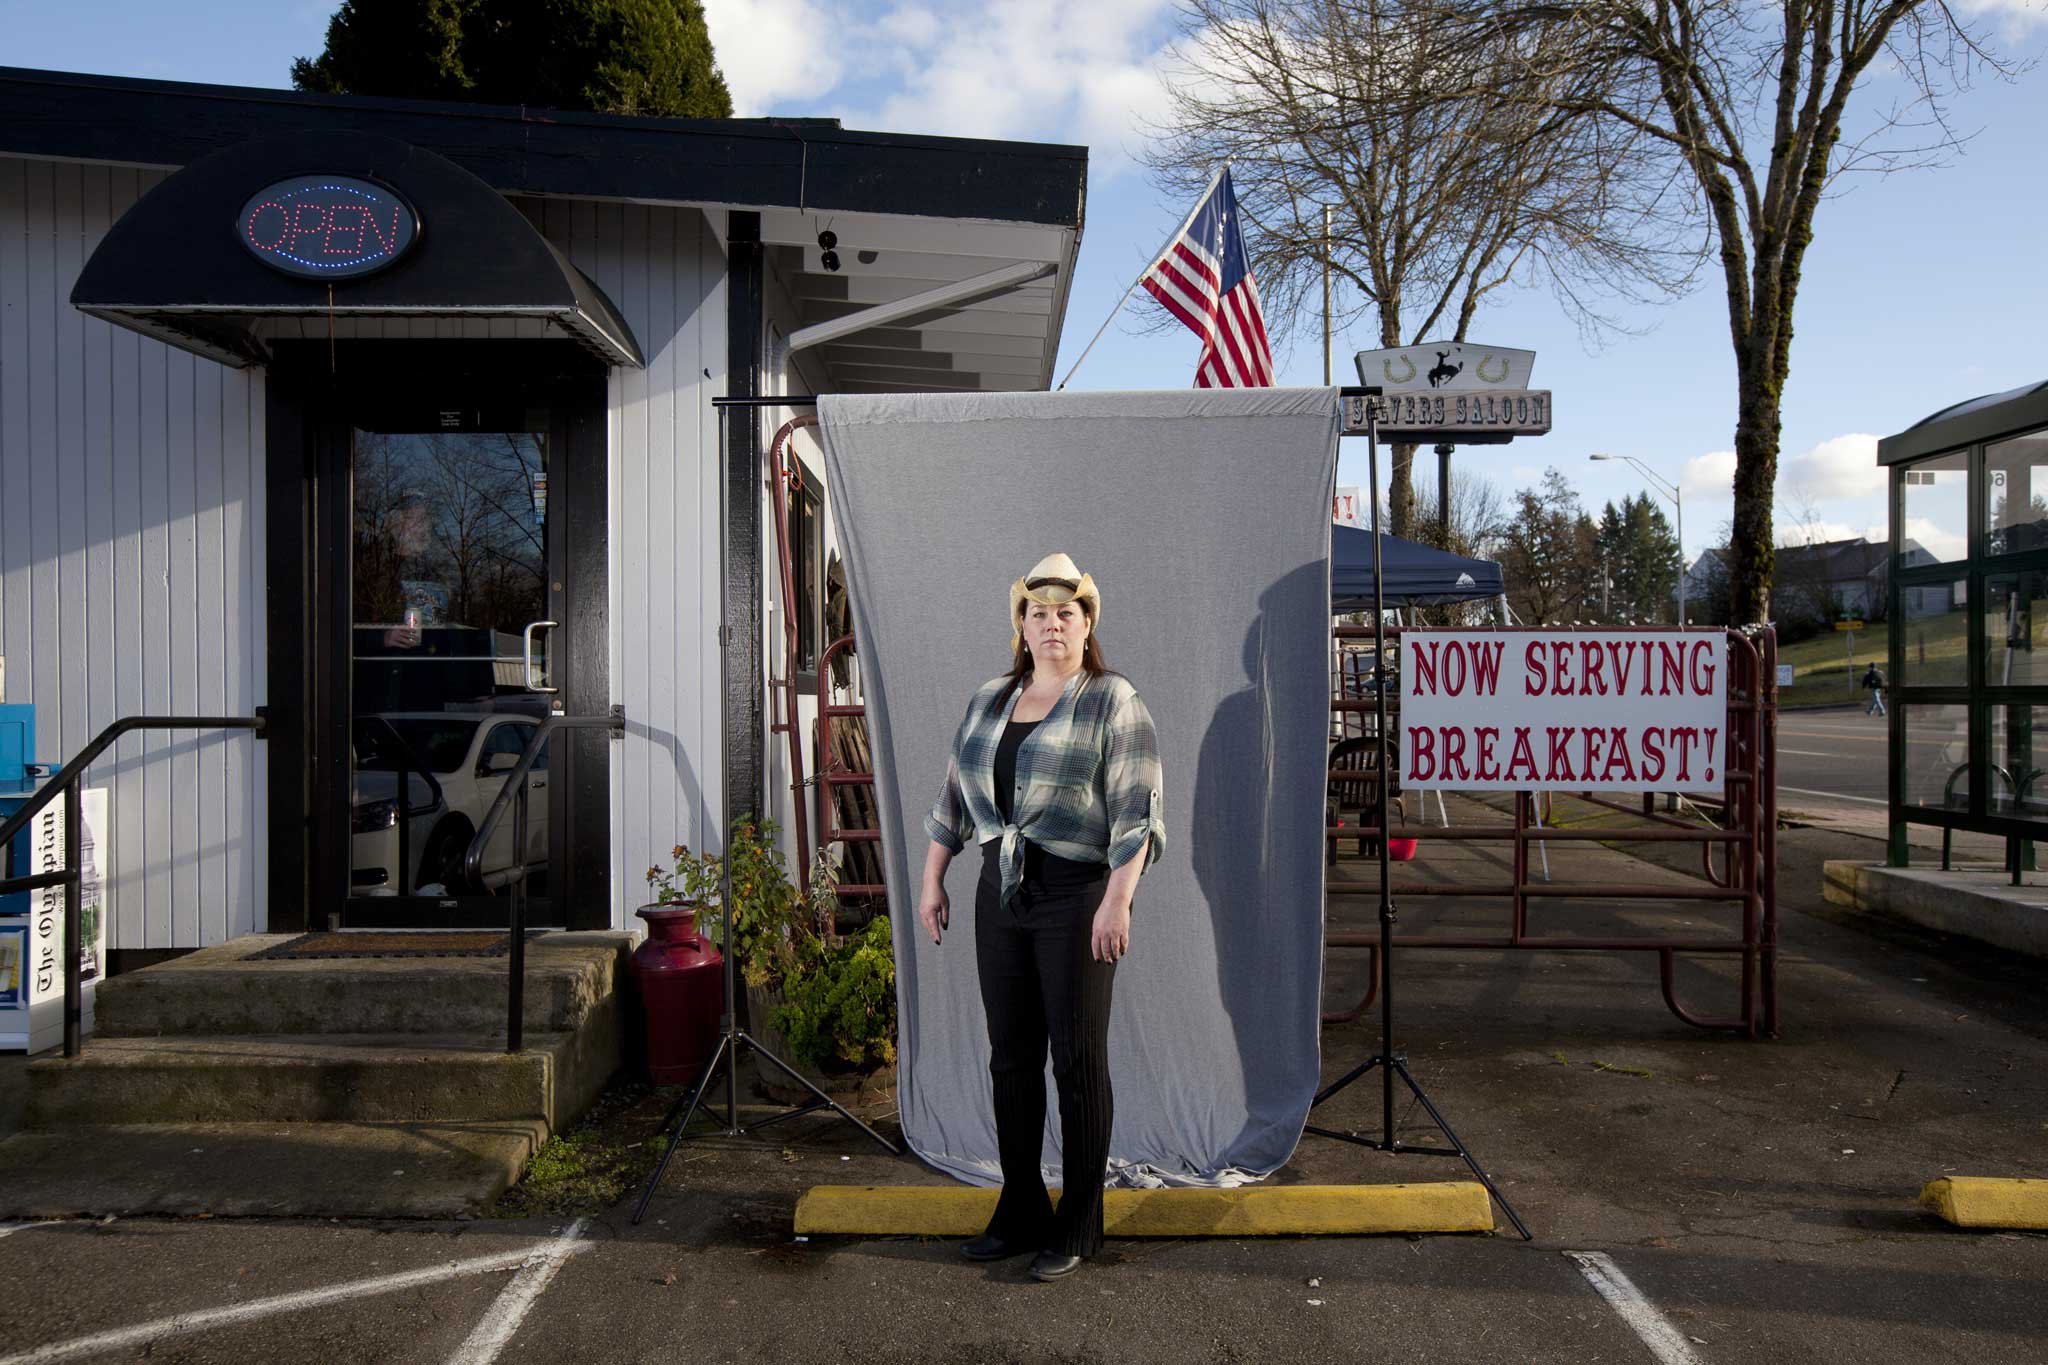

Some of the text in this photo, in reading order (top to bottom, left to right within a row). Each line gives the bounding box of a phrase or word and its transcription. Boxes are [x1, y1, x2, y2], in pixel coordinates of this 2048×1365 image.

[248, 201, 400, 255] OPEN
[1353, 396, 1544, 424] SLVERS SALOON
[1411, 640, 1716, 697] NOW SERVING
[1407, 726, 1718, 782] BREAKFAST!
[37, 946, 55, 994] The
